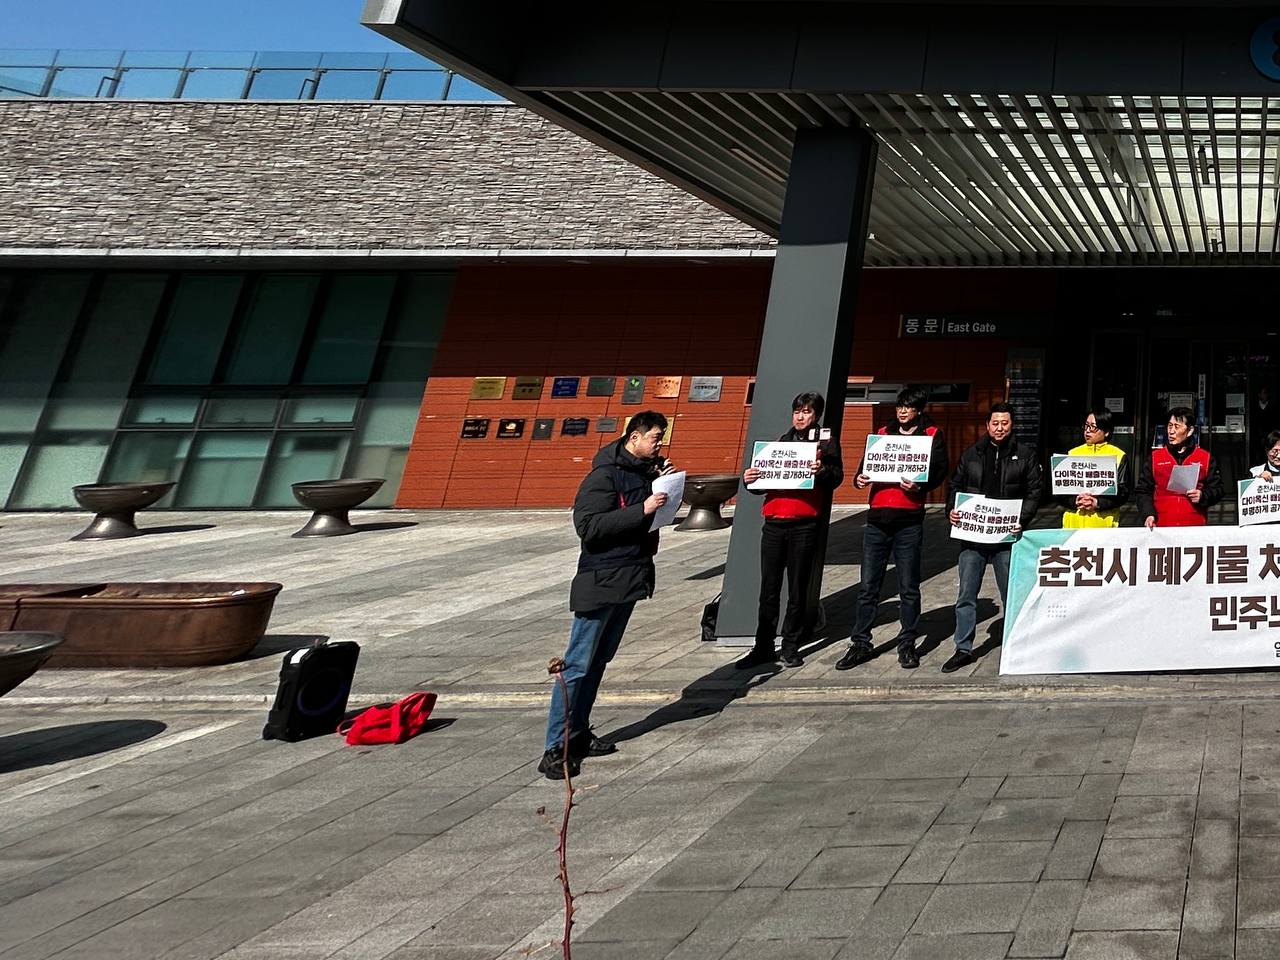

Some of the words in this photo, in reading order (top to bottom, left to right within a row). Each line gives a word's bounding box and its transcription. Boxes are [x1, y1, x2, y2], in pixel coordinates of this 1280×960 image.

[947, 322, 970, 333] East
[972, 322, 997, 333] Gate
[885, 443, 912, 451] 춘천시는
[867, 453, 896, 462] 다이옥신
[754, 460, 782, 468] 다이옥신
[866, 464, 895, 472] 투명하게
[897, 464, 927, 473] 공개하라
[759, 471, 781, 479] 명하게
[1054, 470, 1083, 478] 다이옥신
[1242, 494, 1269, 505] 다이옥신
[975, 504, 1001, 514] 춘천시는
[1038, 546, 1138, 587] 춘천시
[1147, 544, 1249, 585] 폐기물
